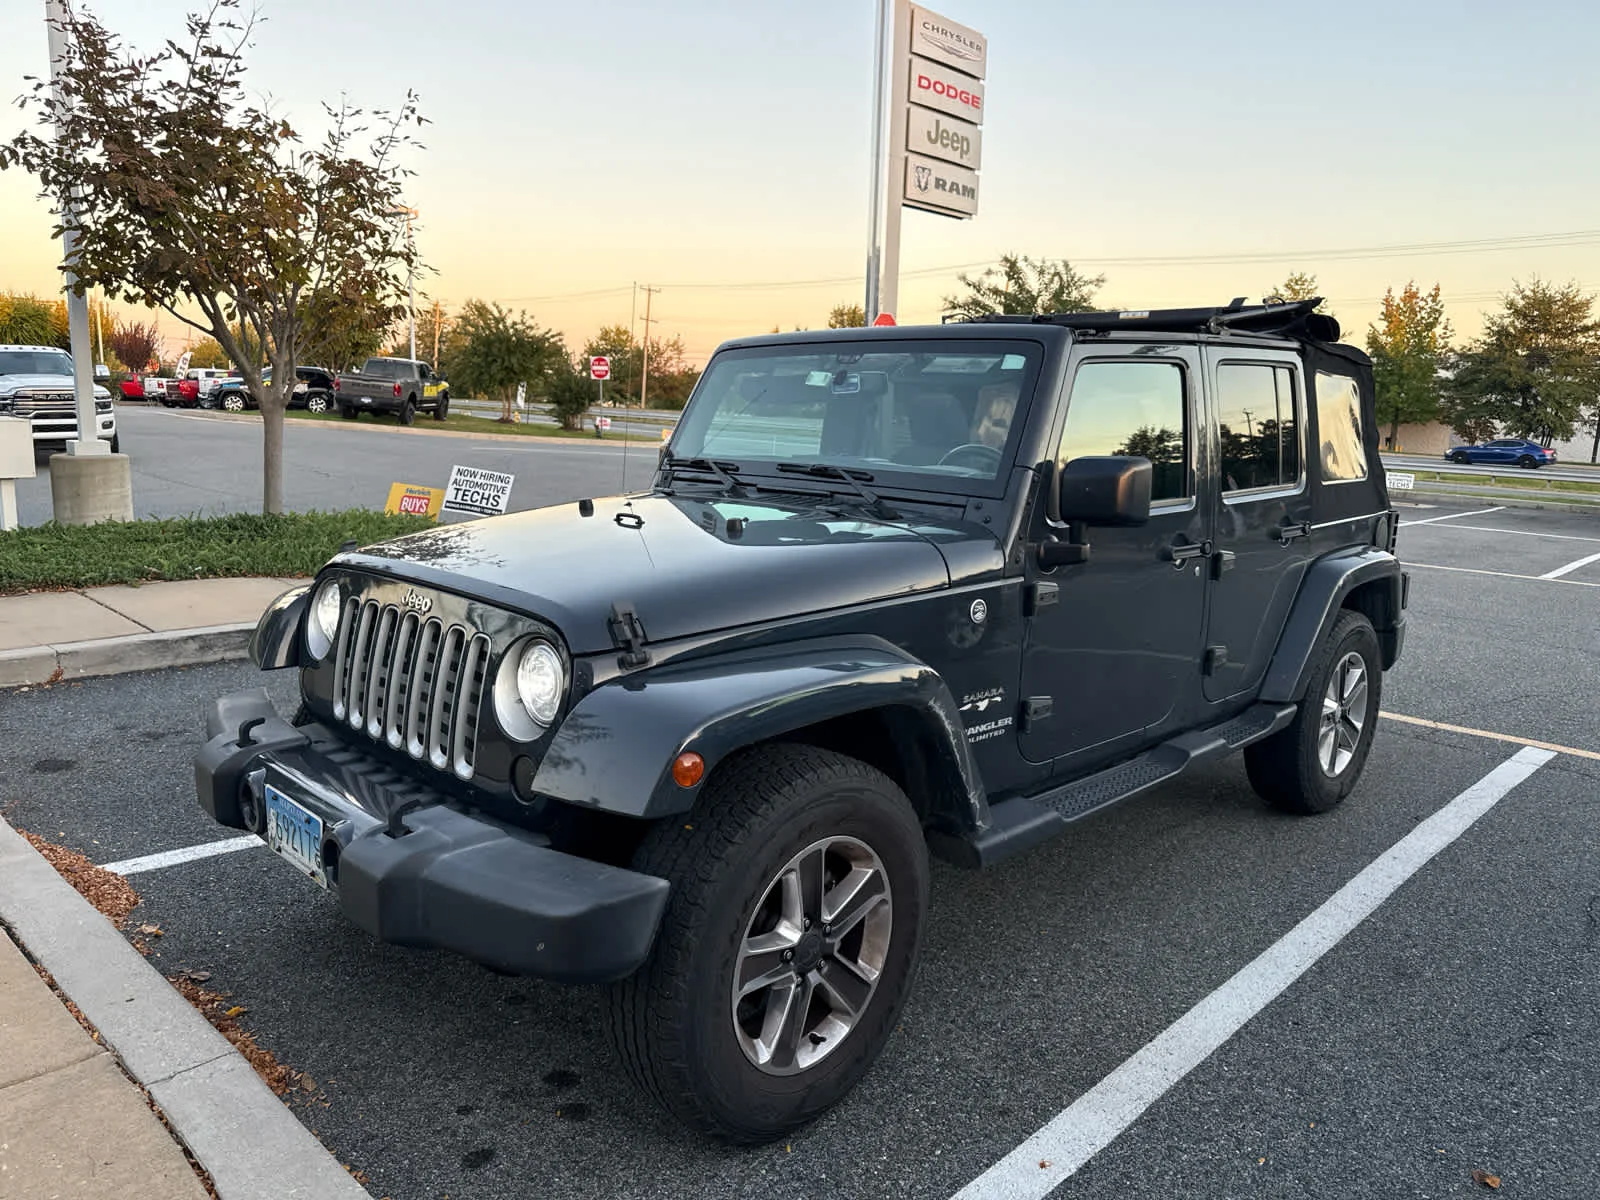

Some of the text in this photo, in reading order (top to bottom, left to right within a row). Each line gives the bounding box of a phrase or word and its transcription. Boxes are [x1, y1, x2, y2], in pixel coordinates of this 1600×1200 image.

[922, 21, 982, 51] CHRYSLER
[917, 74, 981, 110] DODGE
[926, 119, 970, 160] Jeep
[934, 176, 976, 200] RAM
[456, 467, 511, 484] NOW HIRING
[452, 478, 508, 495] AUTOMOTIVE
[400, 496, 429, 513] BUYS
[453, 488, 501, 507] TECHS
[401, 587, 432, 616] Jeep
[963, 686, 1005, 703] SAHARA
[966, 716, 1013, 736] ANGLER
[968, 728, 1006, 743] LIMITED
